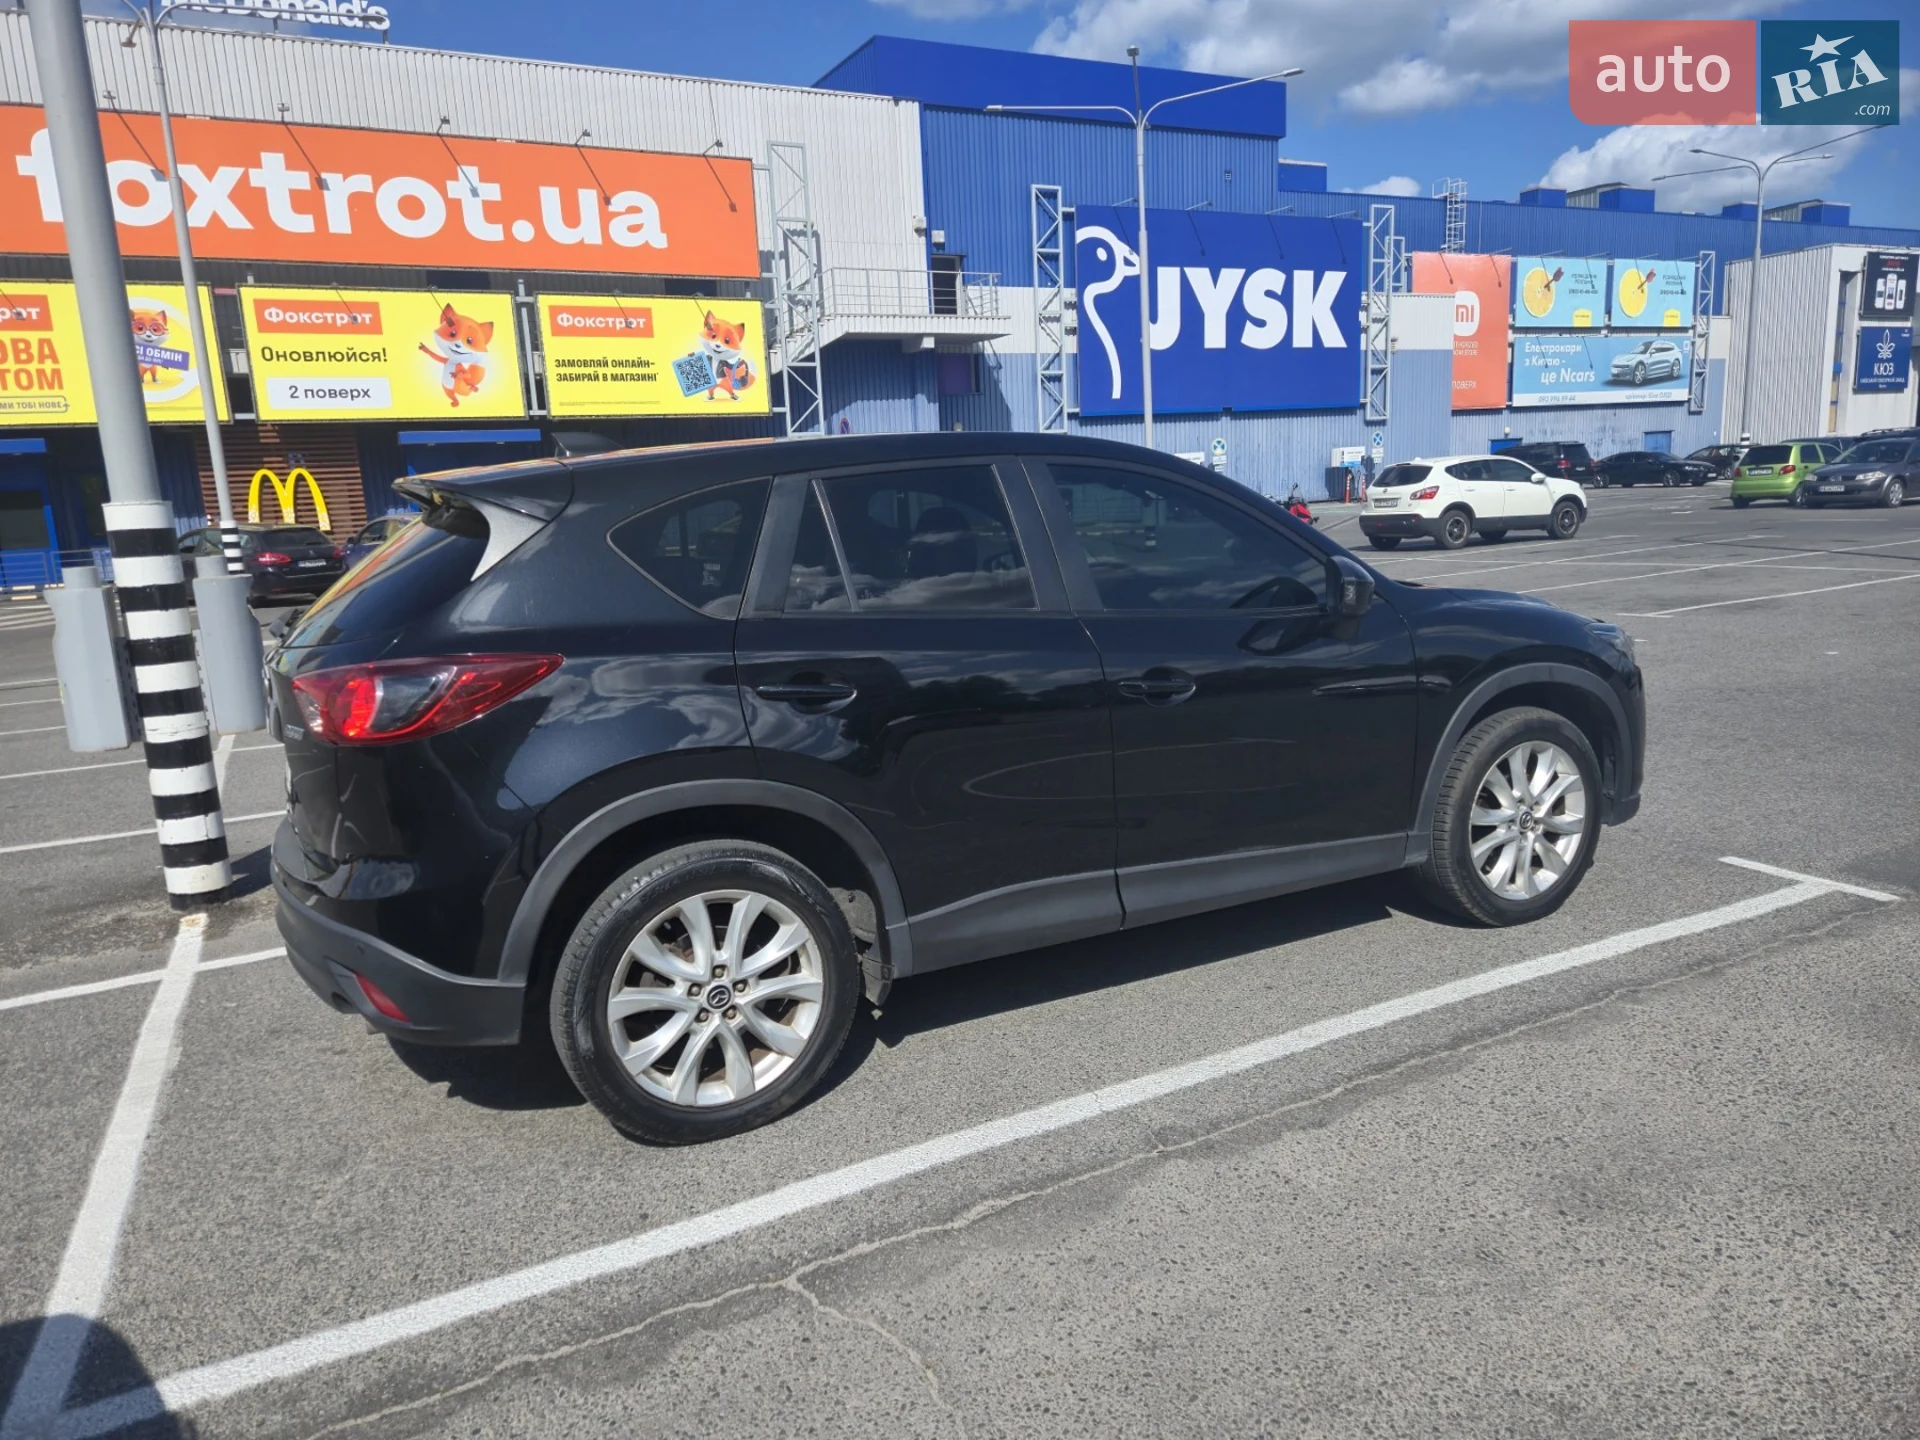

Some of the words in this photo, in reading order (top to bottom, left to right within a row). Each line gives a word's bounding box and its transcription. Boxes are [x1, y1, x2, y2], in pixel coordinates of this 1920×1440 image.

[15, 127, 668, 249] foxtrot.ua
[1141, 266, 1348, 350] JYSK
[263, 307, 373, 327] Фокстрот
[556, 312, 646, 330] Фокстрот
[146, 347, 182, 362] ОБМІН
[261, 346, 388, 362] Оновлюйся!
[1524, 342, 1582, 355] Електрокари
[554, 356, 609, 368] ЗАМОВЛЯЙ
[611, 356, 655, 368] ОНЛАЙН-
[1524, 358, 1530, 366] з
[1531, 355, 1560, 366] Китаю
[556, 370, 600, 382] ЗАБИРАЙ
[602, 372, 608, 382] В
[1541, 371, 1557, 385] це
[1560, 368, 1595, 382] Ncars
[1873, 362, 1894, 376] КЮЗ
[288, 385, 299, 399] 2
[304, 388, 371, 401] поверх
[38, 401, 62, 409] НОВЕ
